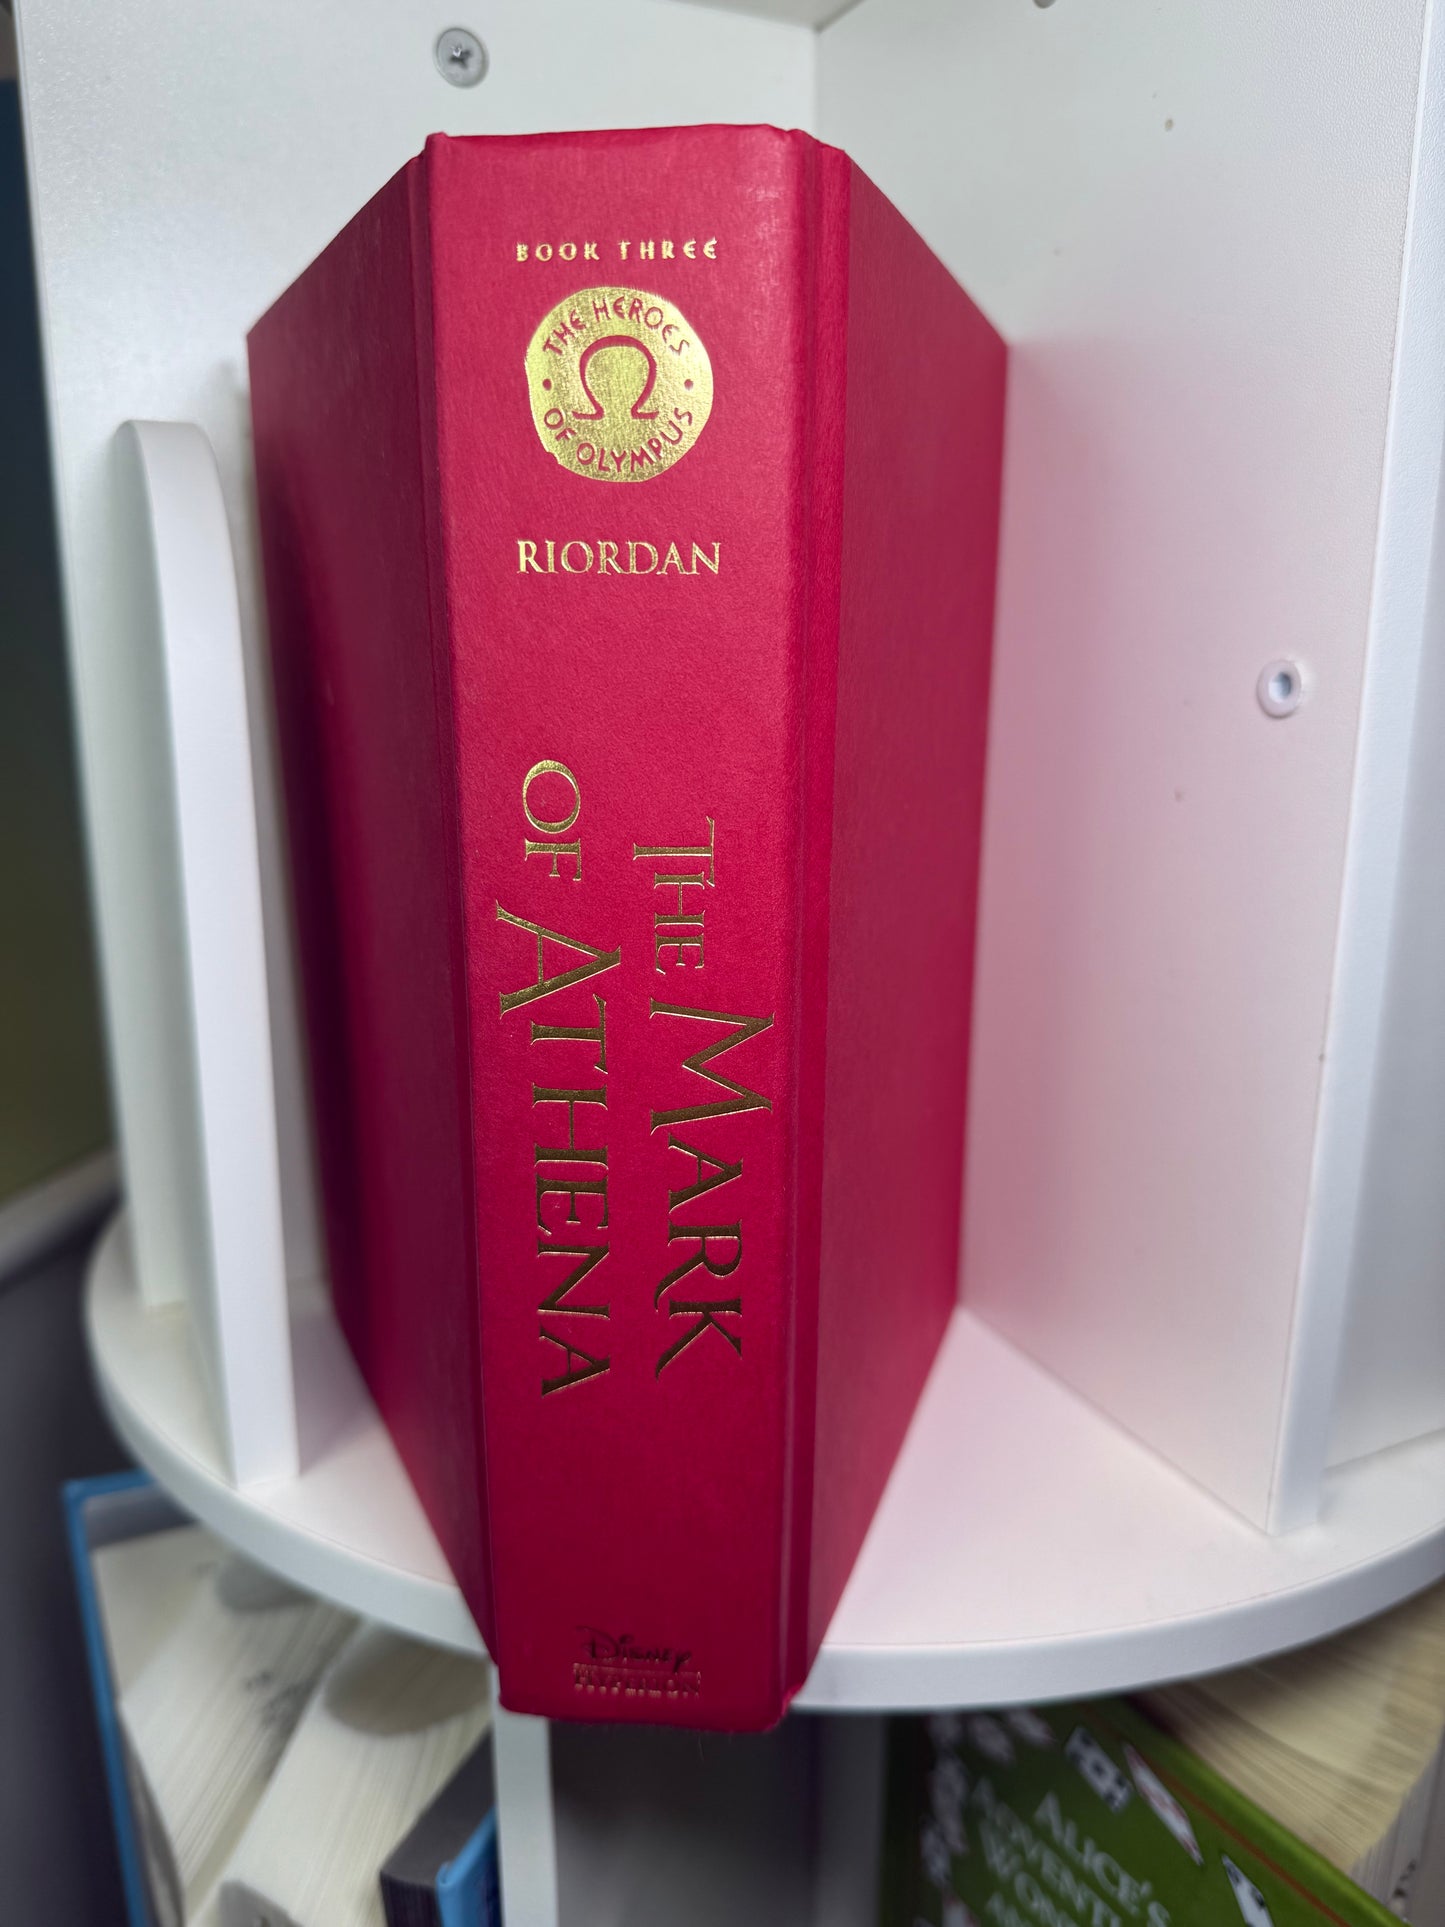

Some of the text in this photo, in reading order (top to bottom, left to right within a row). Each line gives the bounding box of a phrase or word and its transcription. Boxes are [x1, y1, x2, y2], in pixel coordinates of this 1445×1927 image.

[515, 236, 718, 262] BOOK THREE
[542, 295, 691, 357] THE HEROES
[543, 406, 694, 474] OF OLYMPUS
[516, 539, 722, 576] RIORDAN
[494, 758, 622, 1400] OF ATHENA
[632, 816, 776, 1382] THE MARK
